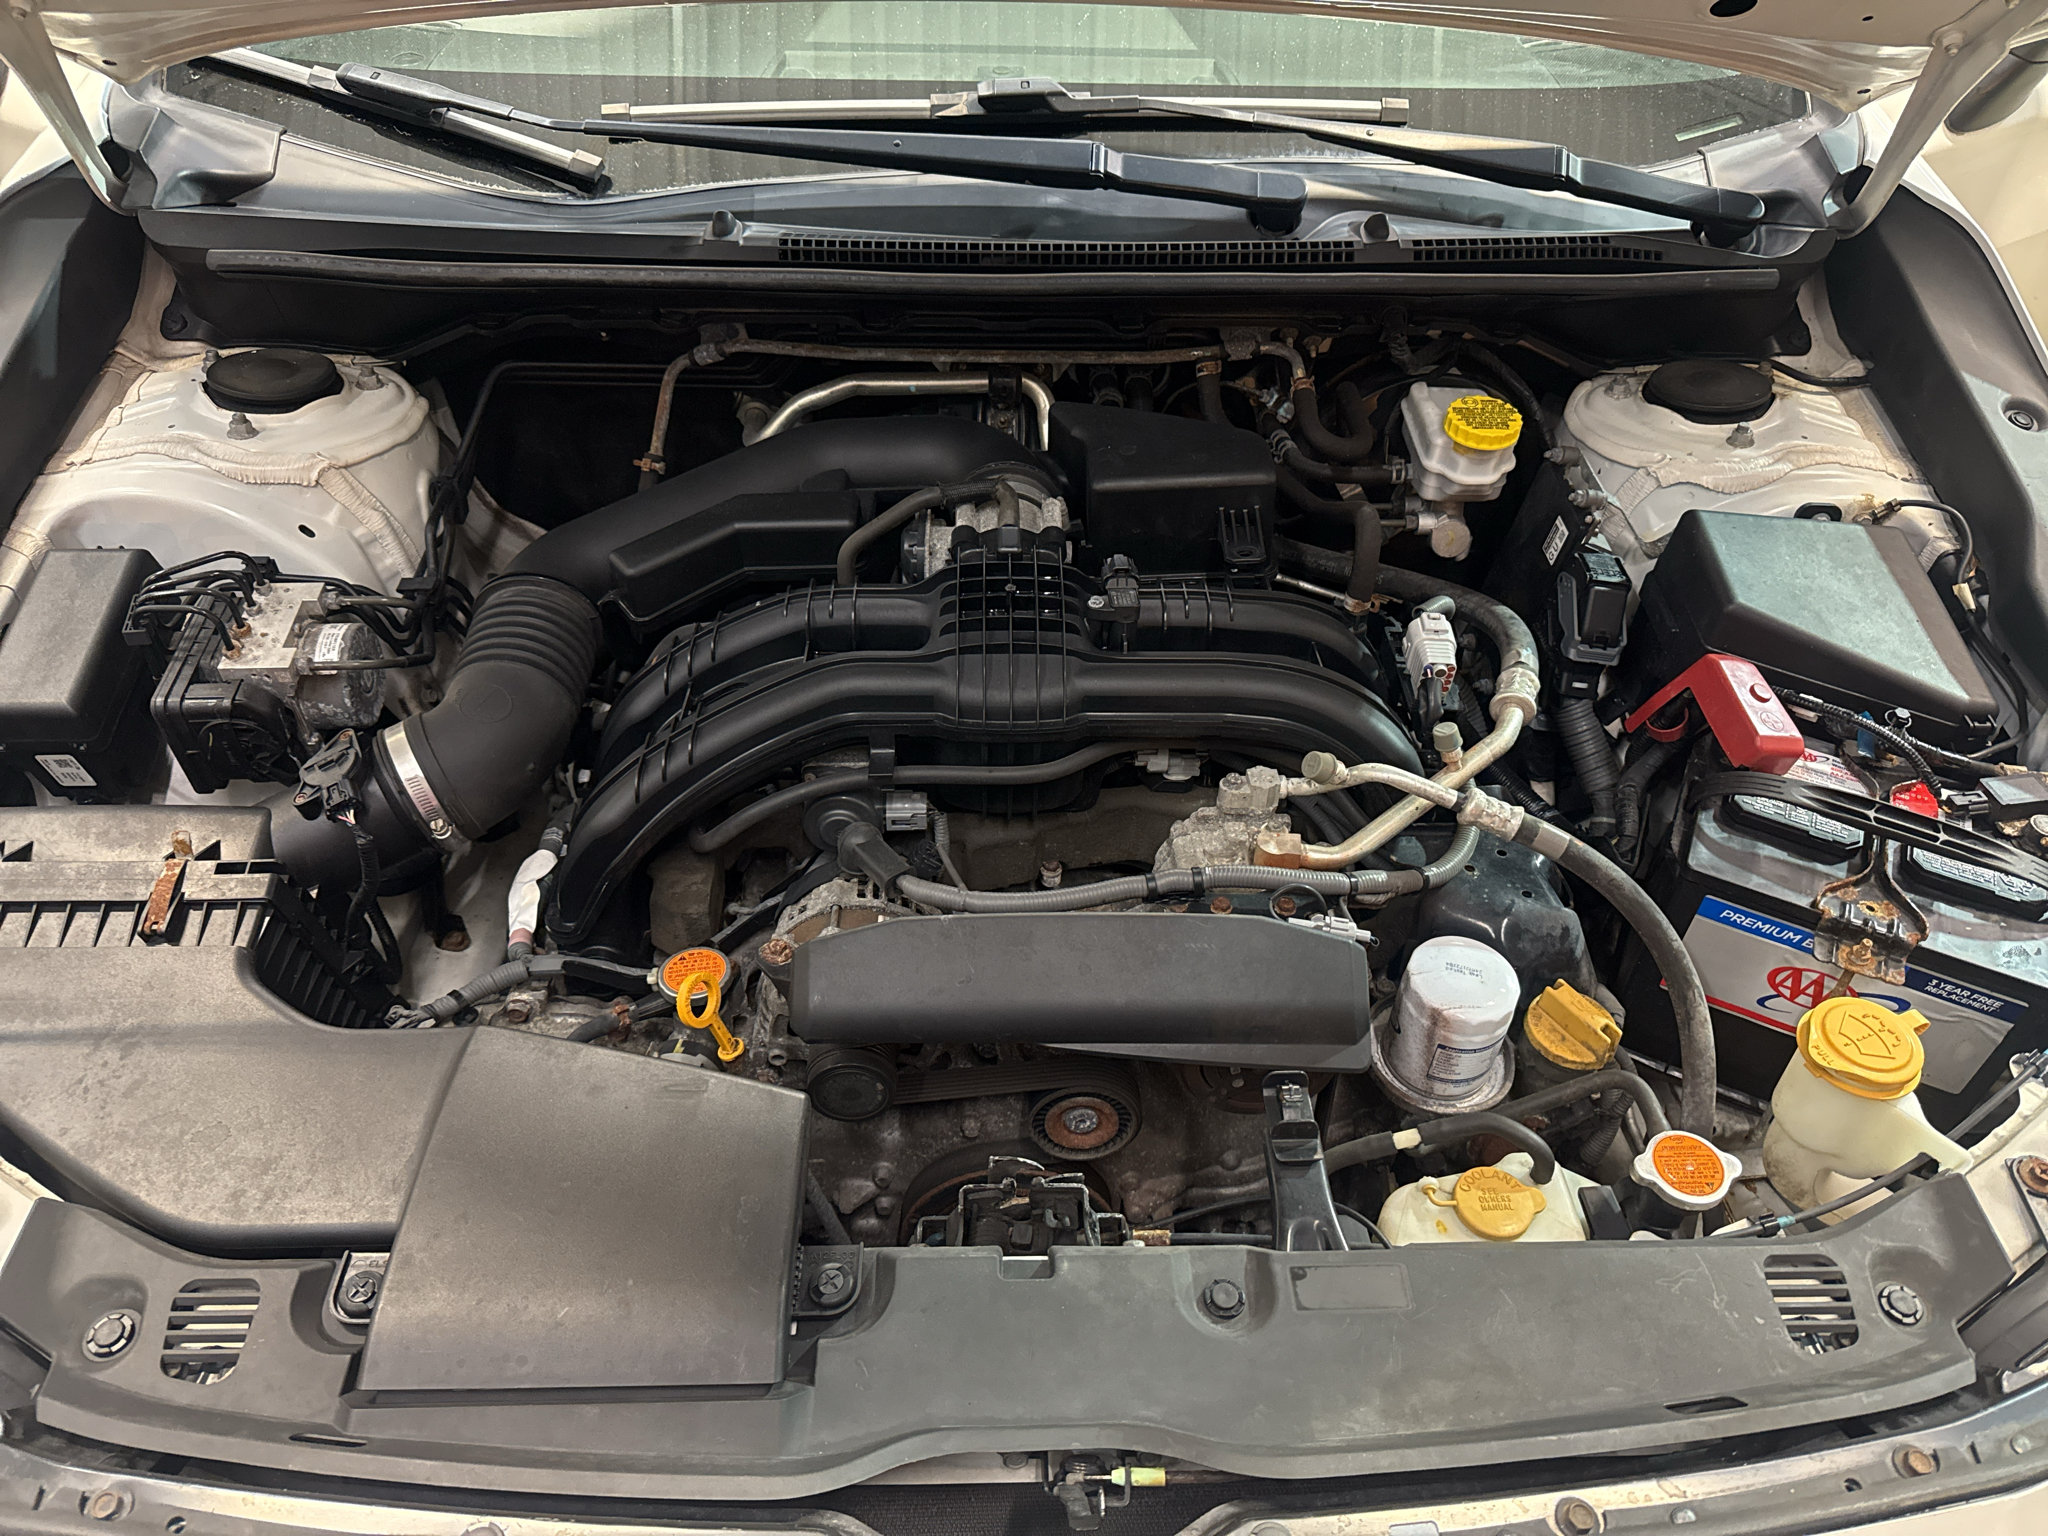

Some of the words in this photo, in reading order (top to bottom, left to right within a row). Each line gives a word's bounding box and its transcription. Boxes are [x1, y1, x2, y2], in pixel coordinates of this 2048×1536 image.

[1720, 909, 1803, 943] PREMIUM
[1768, 966, 1855, 1010] AA
[1924, 985, 1996, 1013] REPLACEMENT
[1928, 978, 1939, 986] 3
[1940, 982, 1971, 998] YEAR
[1970, 993, 2004, 1009] FREE
[1811, 1044, 1834, 1066] PULL
[1459, 1168, 1520, 1192] COOLANT
[1481, 1187, 1499, 1196] SEE
[1480, 1203, 1515, 1211] MANUAL
